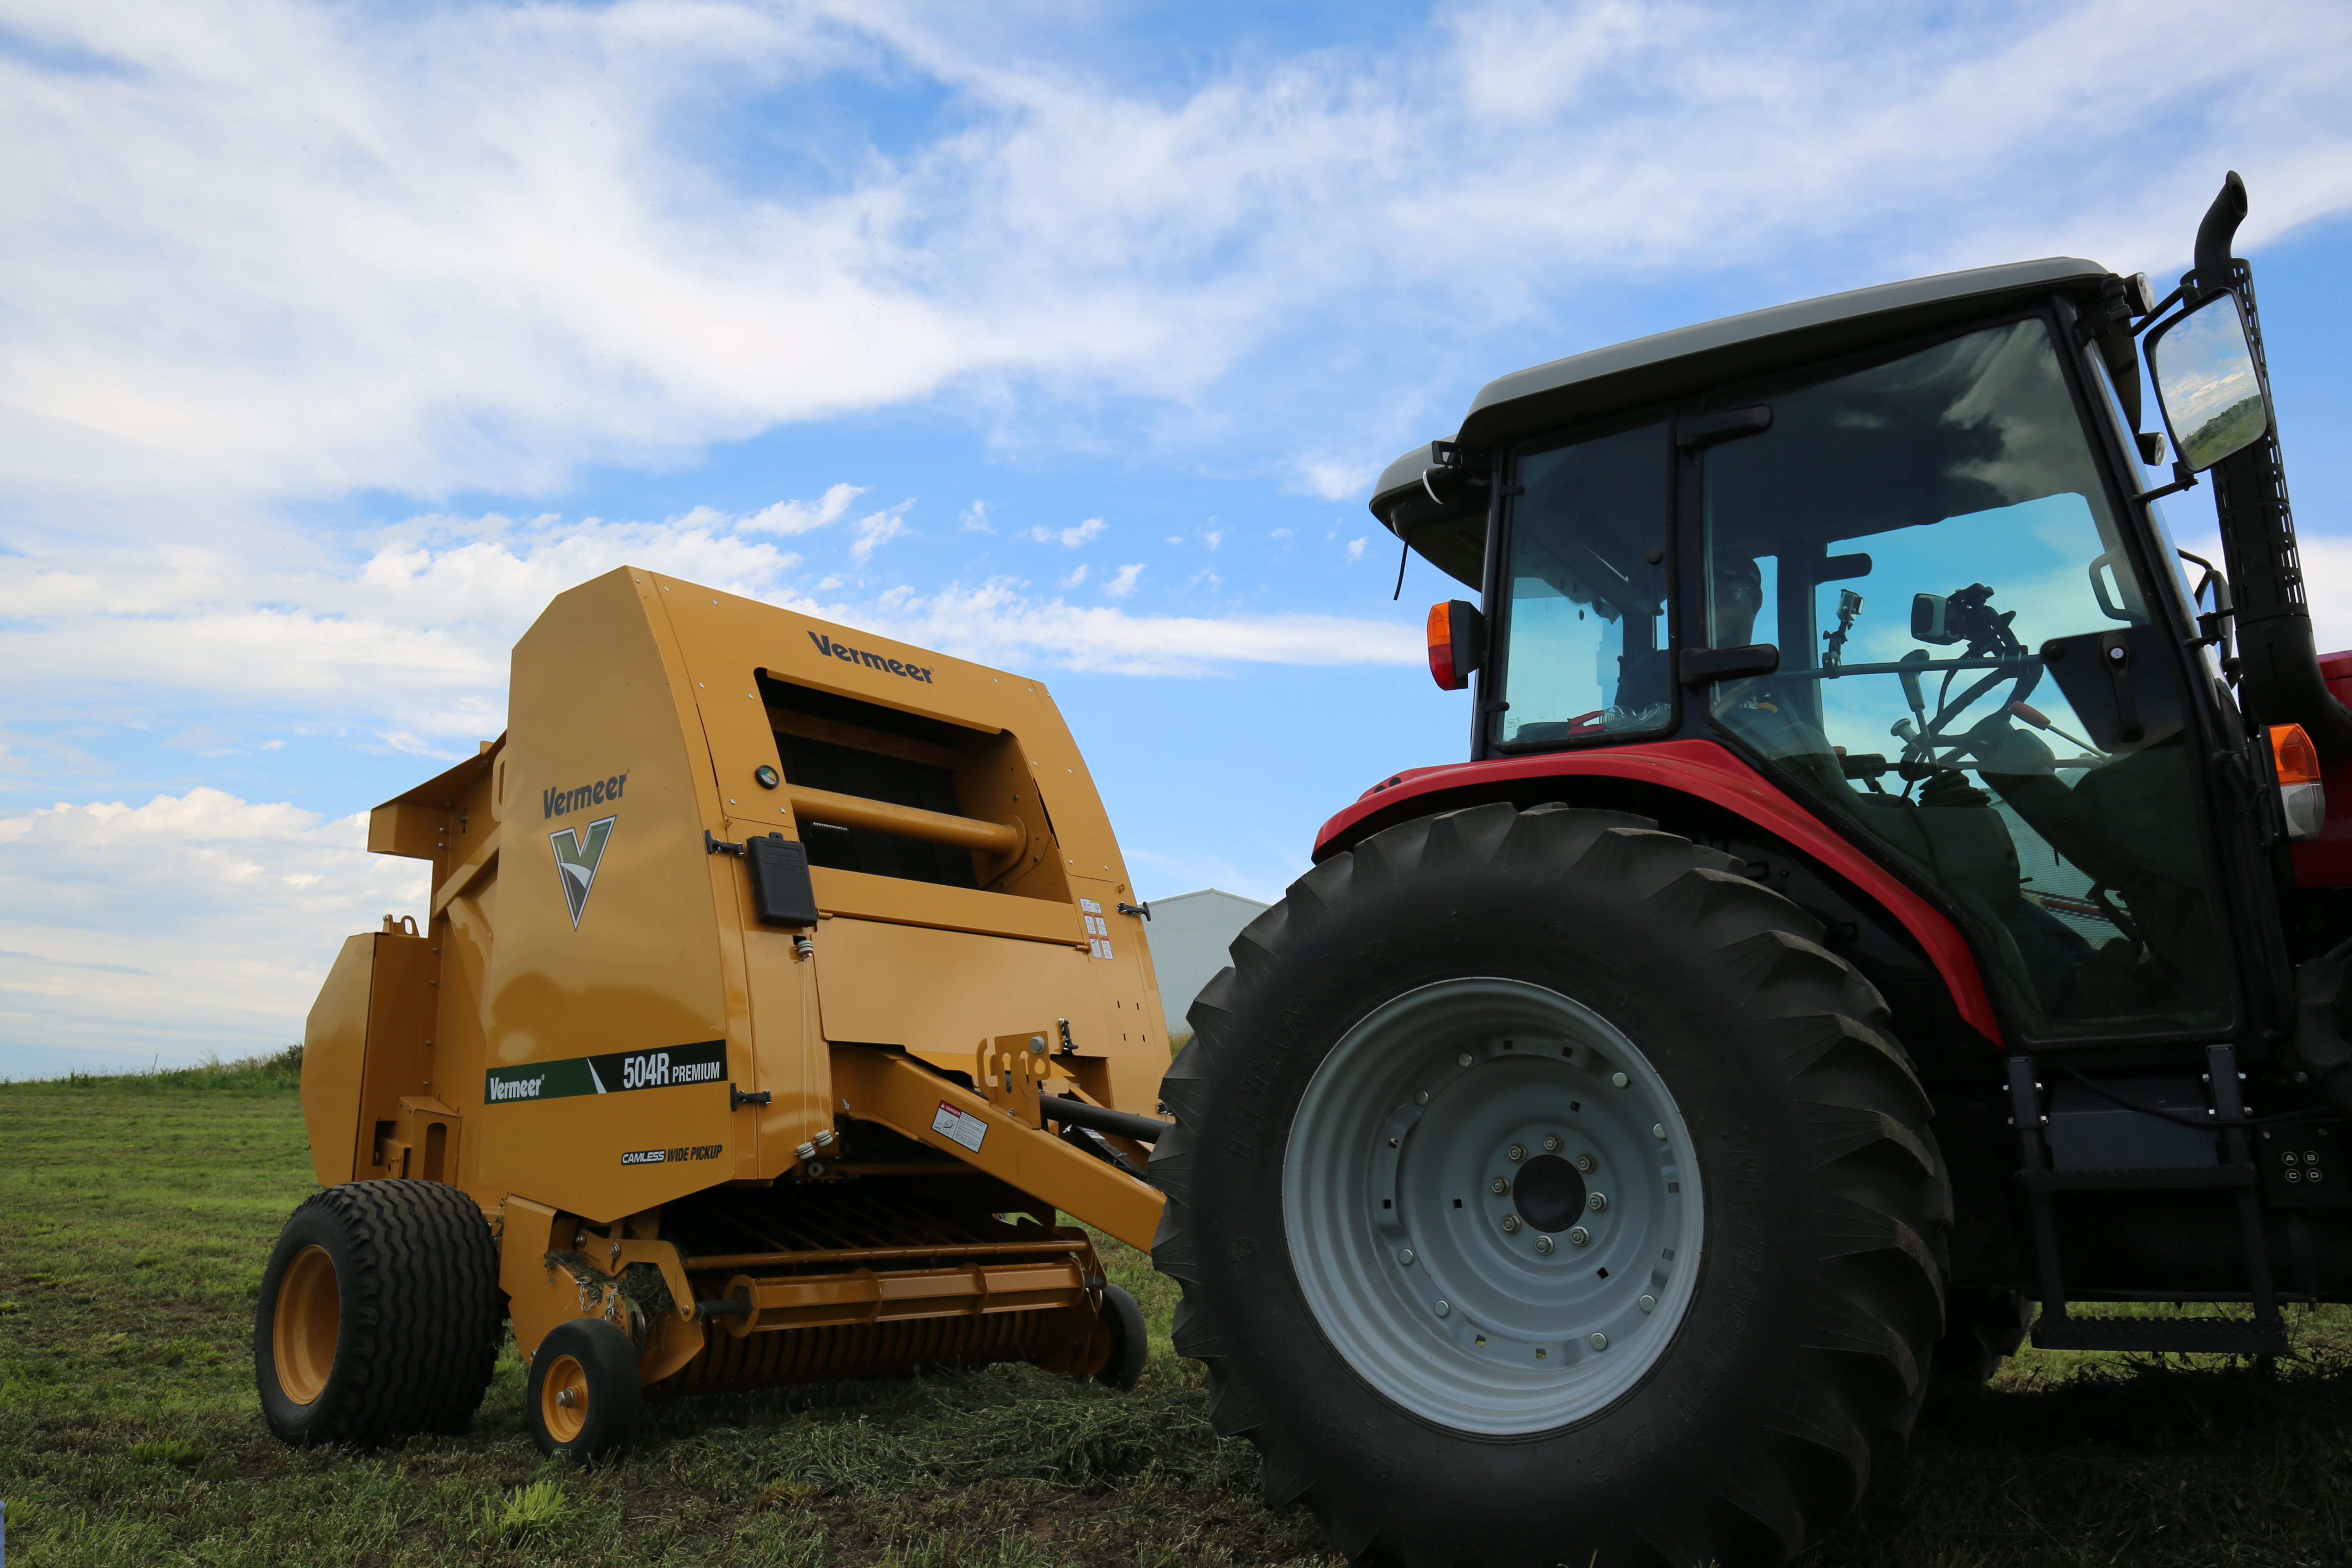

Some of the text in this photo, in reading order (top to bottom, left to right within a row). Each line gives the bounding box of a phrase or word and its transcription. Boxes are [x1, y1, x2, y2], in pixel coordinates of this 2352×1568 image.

[806, 630, 933, 684] Vermeer
[543, 773, 627, 819] Vermeer
[490, 1077, 541, 1100] Vermeer
[623, 1053, 719, 1088] 504R PREMIUM
[1223, 993, 1313, 1165] TITAN
[945, 1105, 960, 1116] DANGER
[622, 1145, 722, 1163] CAMLESS WIDE PICKUP
[1590, 1149, 1764, 1484] HI-TRACTION LUG
